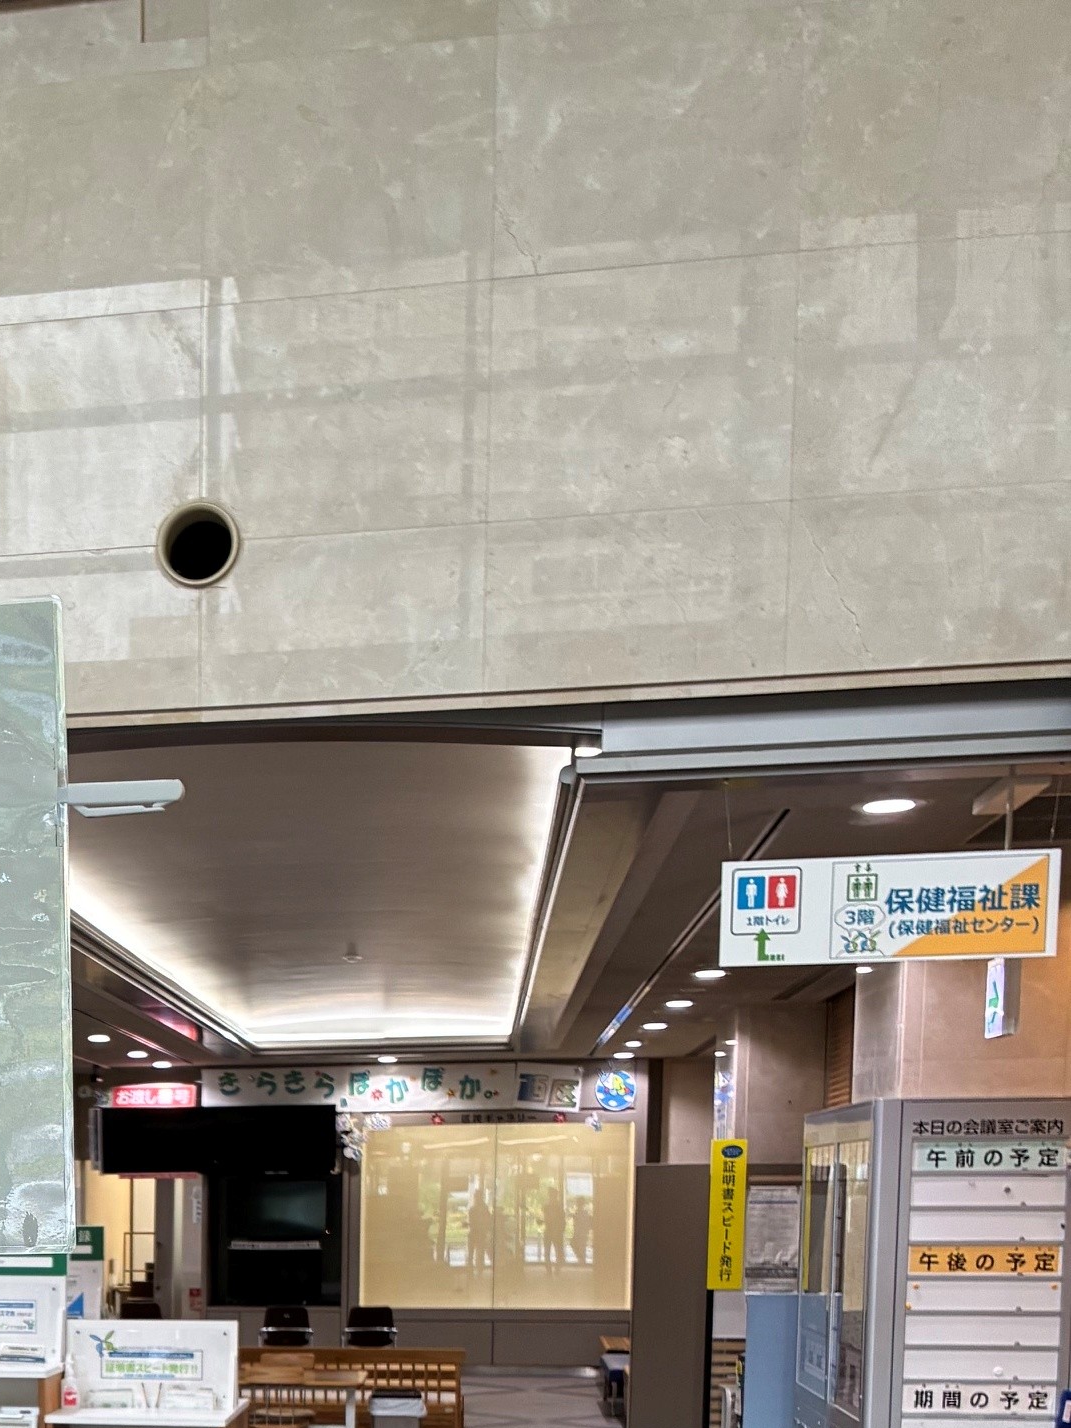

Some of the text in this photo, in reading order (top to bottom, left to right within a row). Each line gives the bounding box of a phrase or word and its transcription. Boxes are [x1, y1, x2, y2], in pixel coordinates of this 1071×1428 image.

[884, 882, 1041, 916] 保健福祉課
[746, 915, 790, 927] 1階トイレ
[845, 910, 875, 926] 3階
[912, 1118, 1064, 1136] 本日の会議室ご案内
[926, 1147, 1060, 1168] 午前の予定
[919, 1252, 1056, 1273] 午後の予定
[913, 1389, 1049, 1411] 期間の予定
